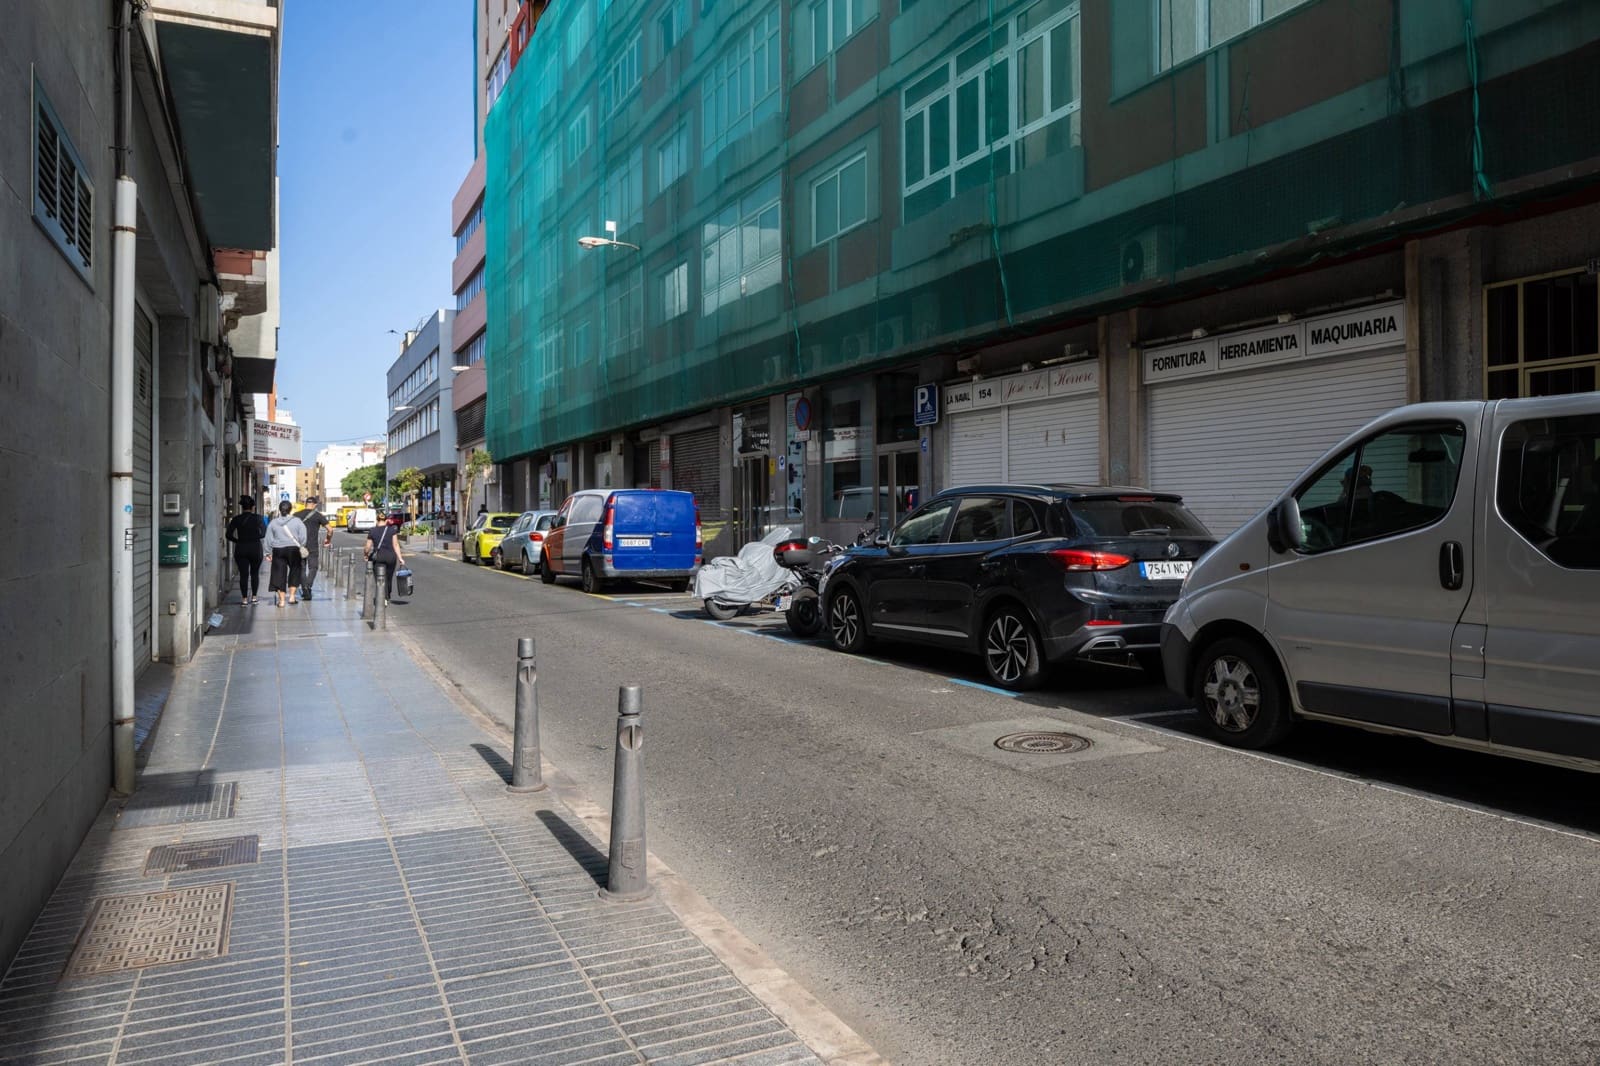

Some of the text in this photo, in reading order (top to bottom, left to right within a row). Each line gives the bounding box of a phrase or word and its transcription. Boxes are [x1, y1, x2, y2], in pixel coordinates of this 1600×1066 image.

[1152, 315, 1397, 371] FORNITURA HERRAMIENTA MAQUINARIA
[917, 388, 929, 413] P
[946, 388, 992, 405] LA NAVAL 154
[1148, 563, 1171, 575] 7541
